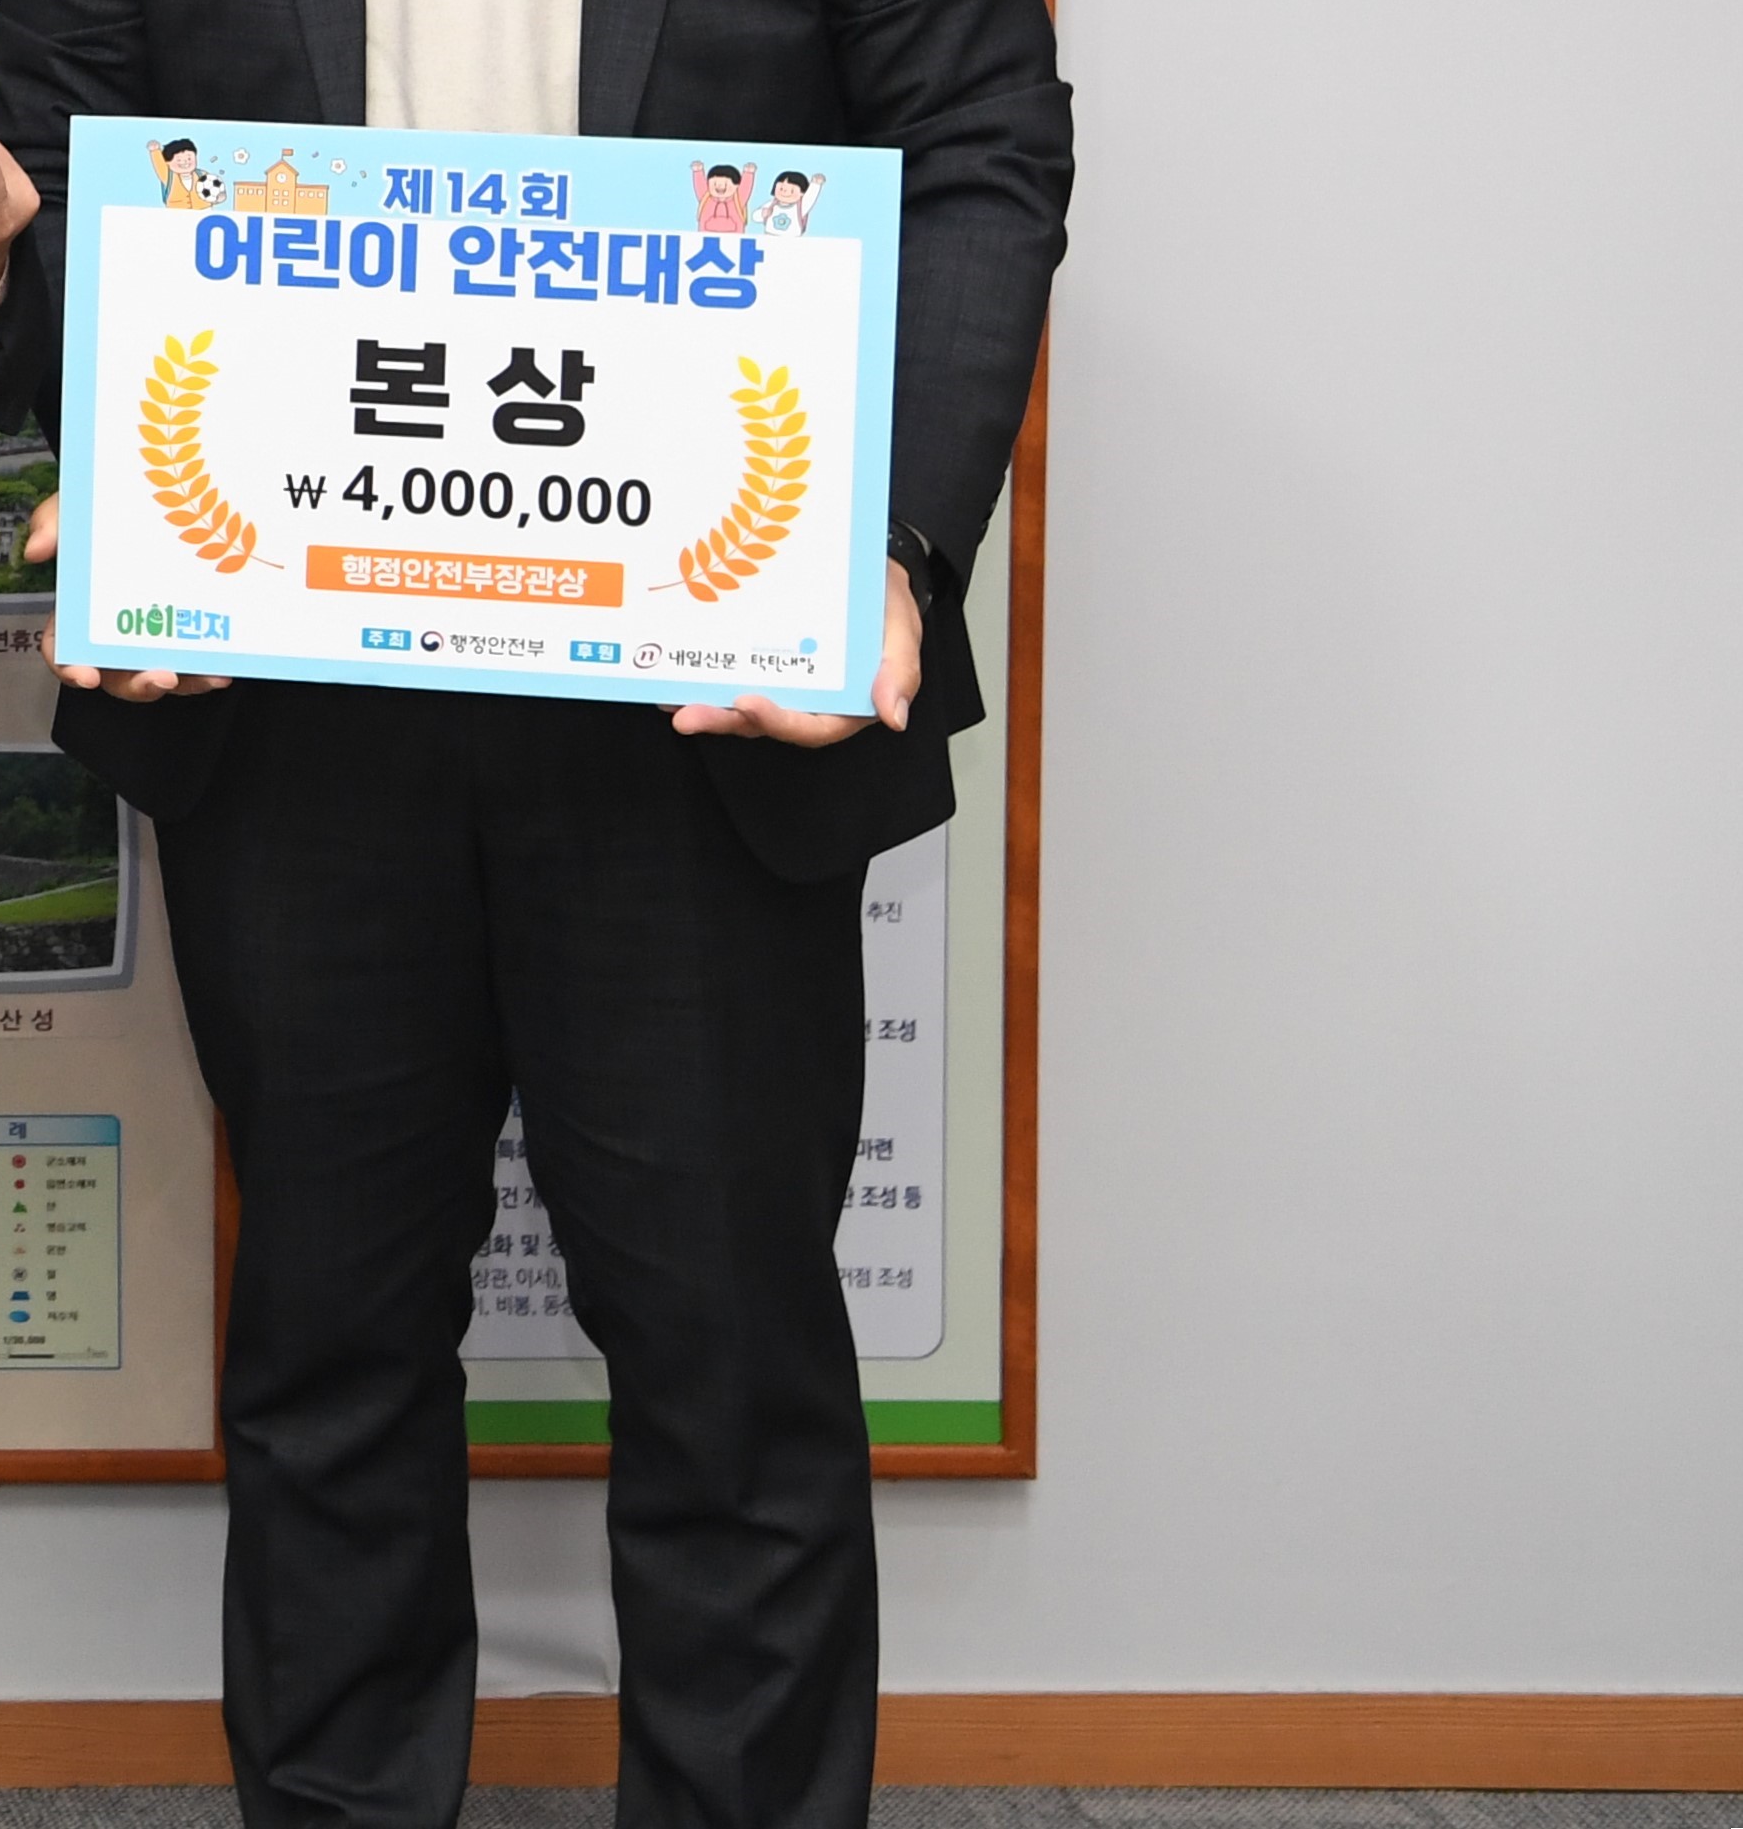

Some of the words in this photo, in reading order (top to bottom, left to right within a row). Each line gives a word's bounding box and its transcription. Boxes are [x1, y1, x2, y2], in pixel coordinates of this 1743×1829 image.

[195, 215, 418, 292] 어린이
[449, 226, 764, 309] 안전대상
[343, 466, 650, 528] 4,000,000
[341, 553, 588, 598] 행정안전부장관상
[450, 634, 544, 657] 행정안전부
[669, 650, 736, 669] 내일신문
